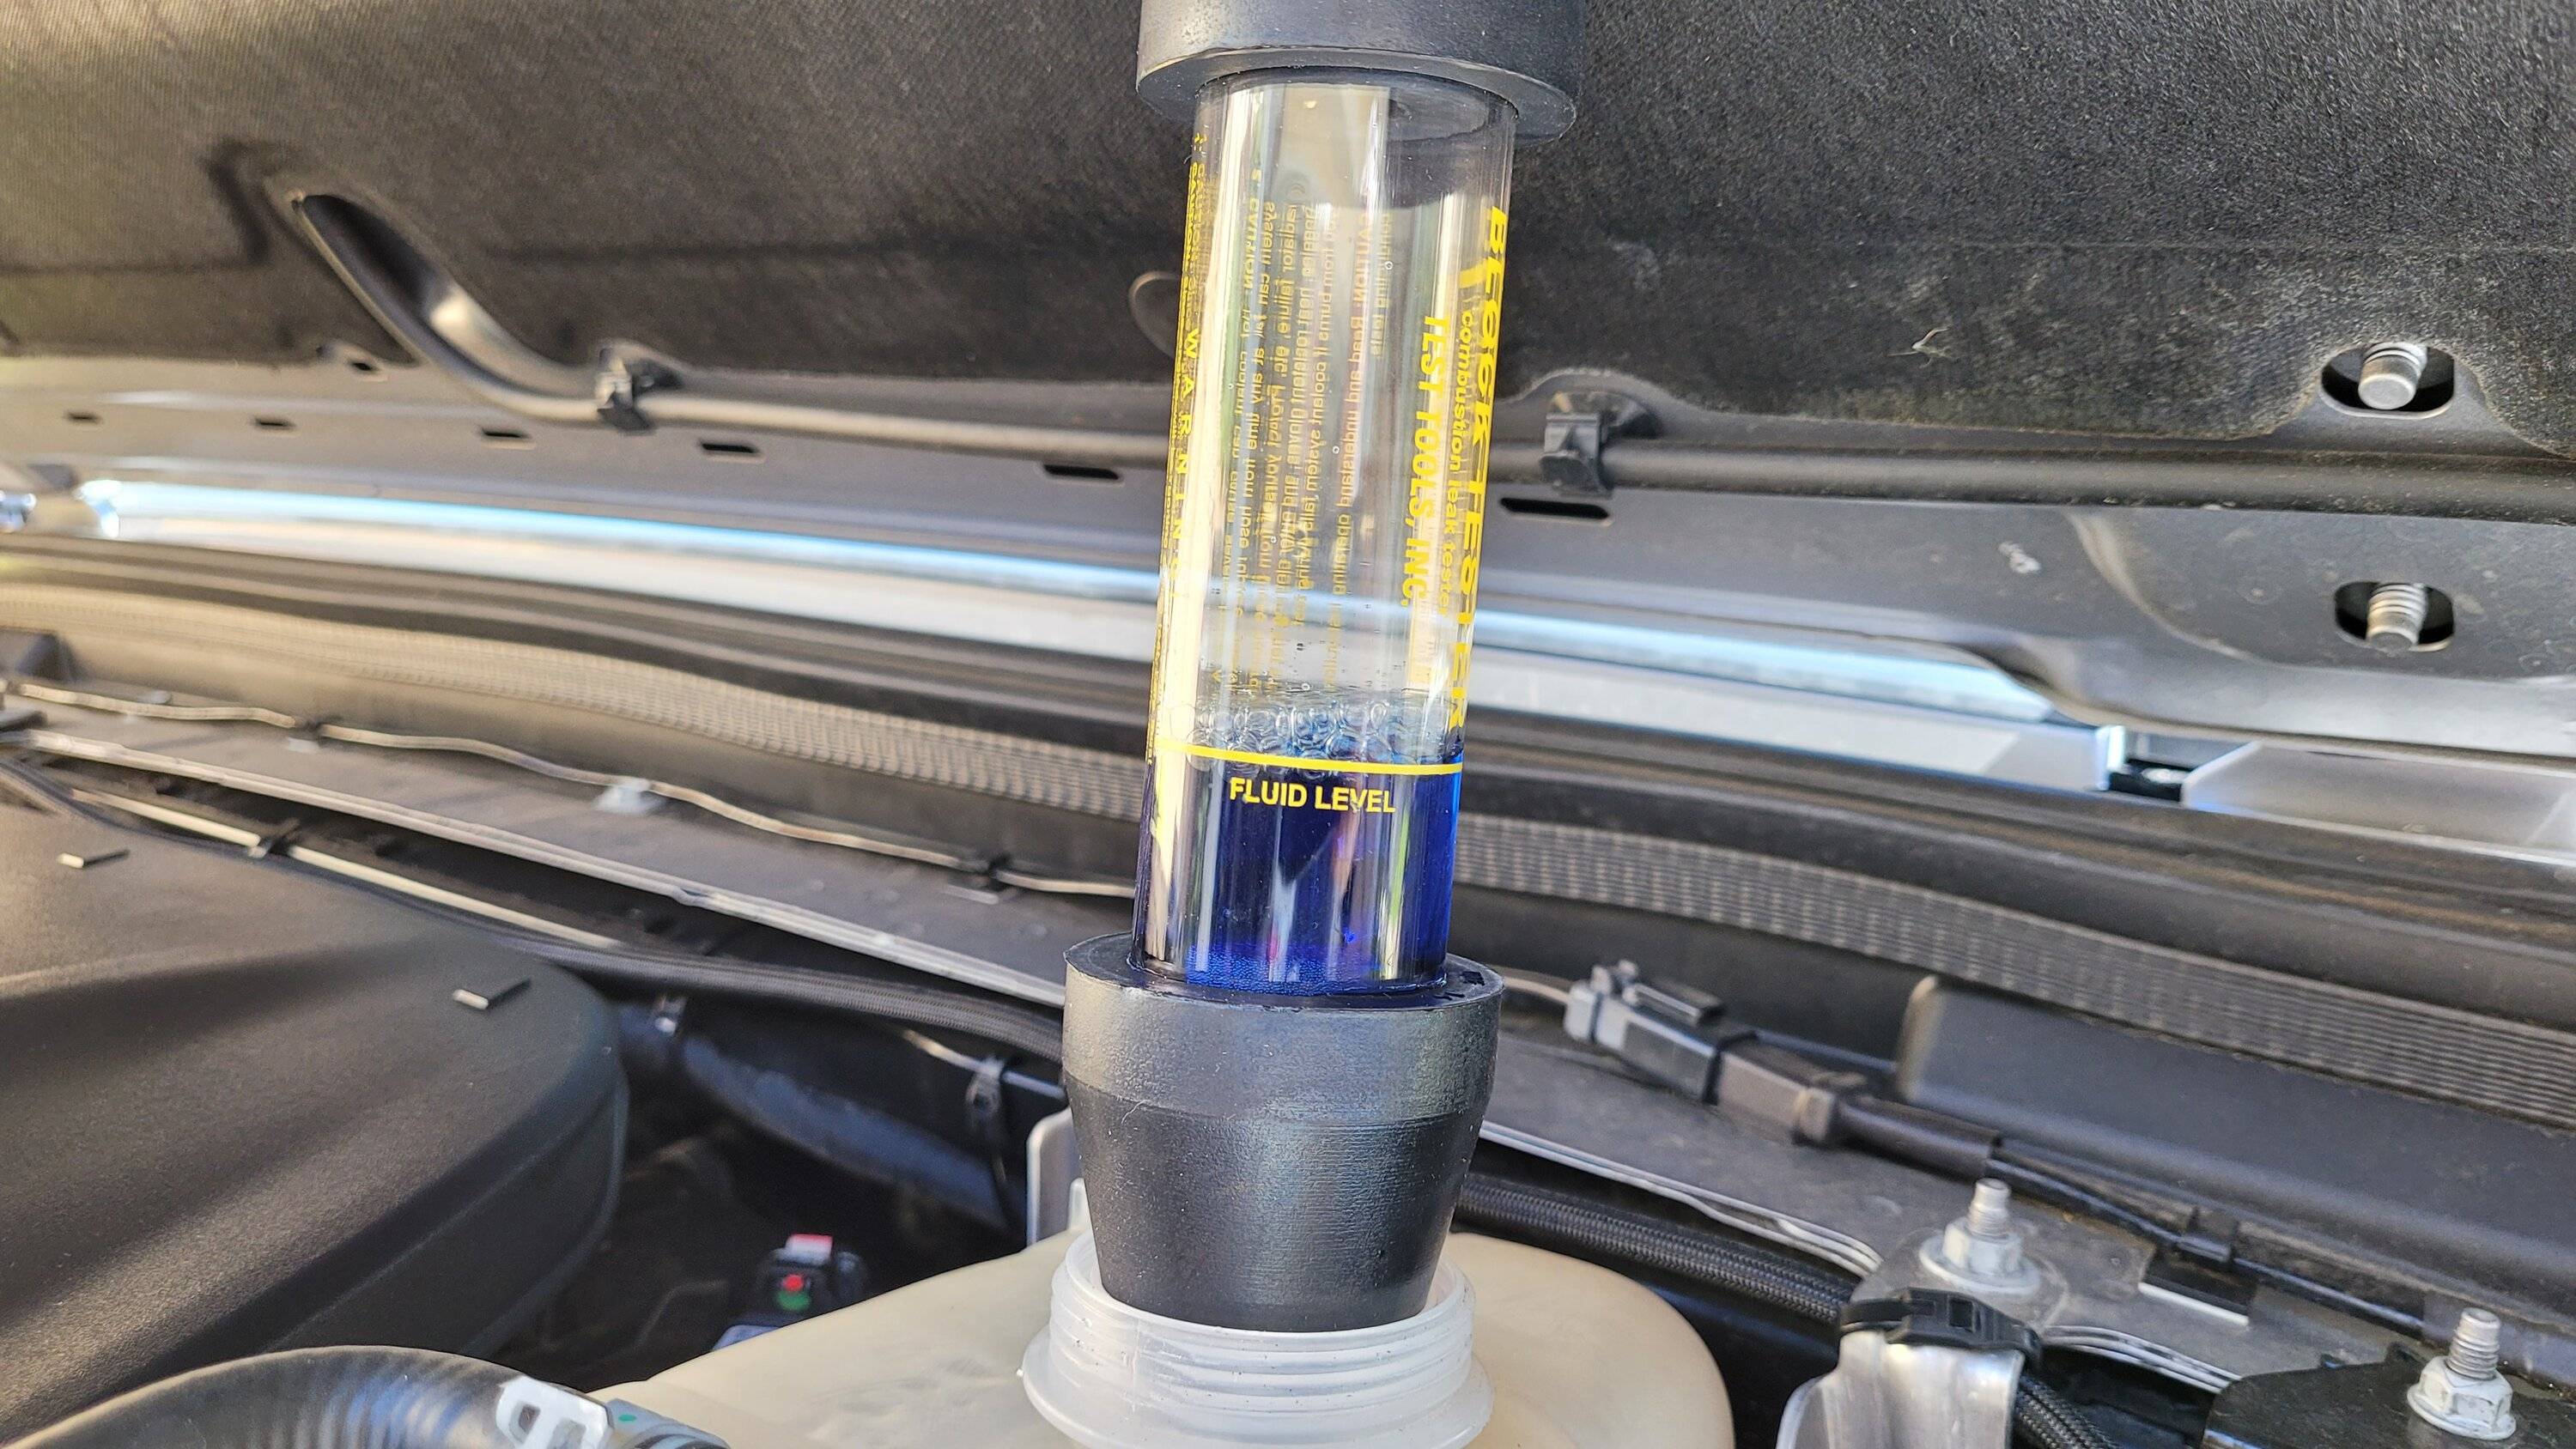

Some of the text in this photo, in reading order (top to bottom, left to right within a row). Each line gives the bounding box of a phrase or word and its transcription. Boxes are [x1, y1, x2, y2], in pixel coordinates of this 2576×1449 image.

[1401, 316, 1449, 606] TEST TOOLS, INC.
[1438, 312, 1473, 616] combustion leak tester
[1449, 206, 1509, 730] BLOCK TESTER
[1229, 777, 1396, 814] FLUID LEVEL
